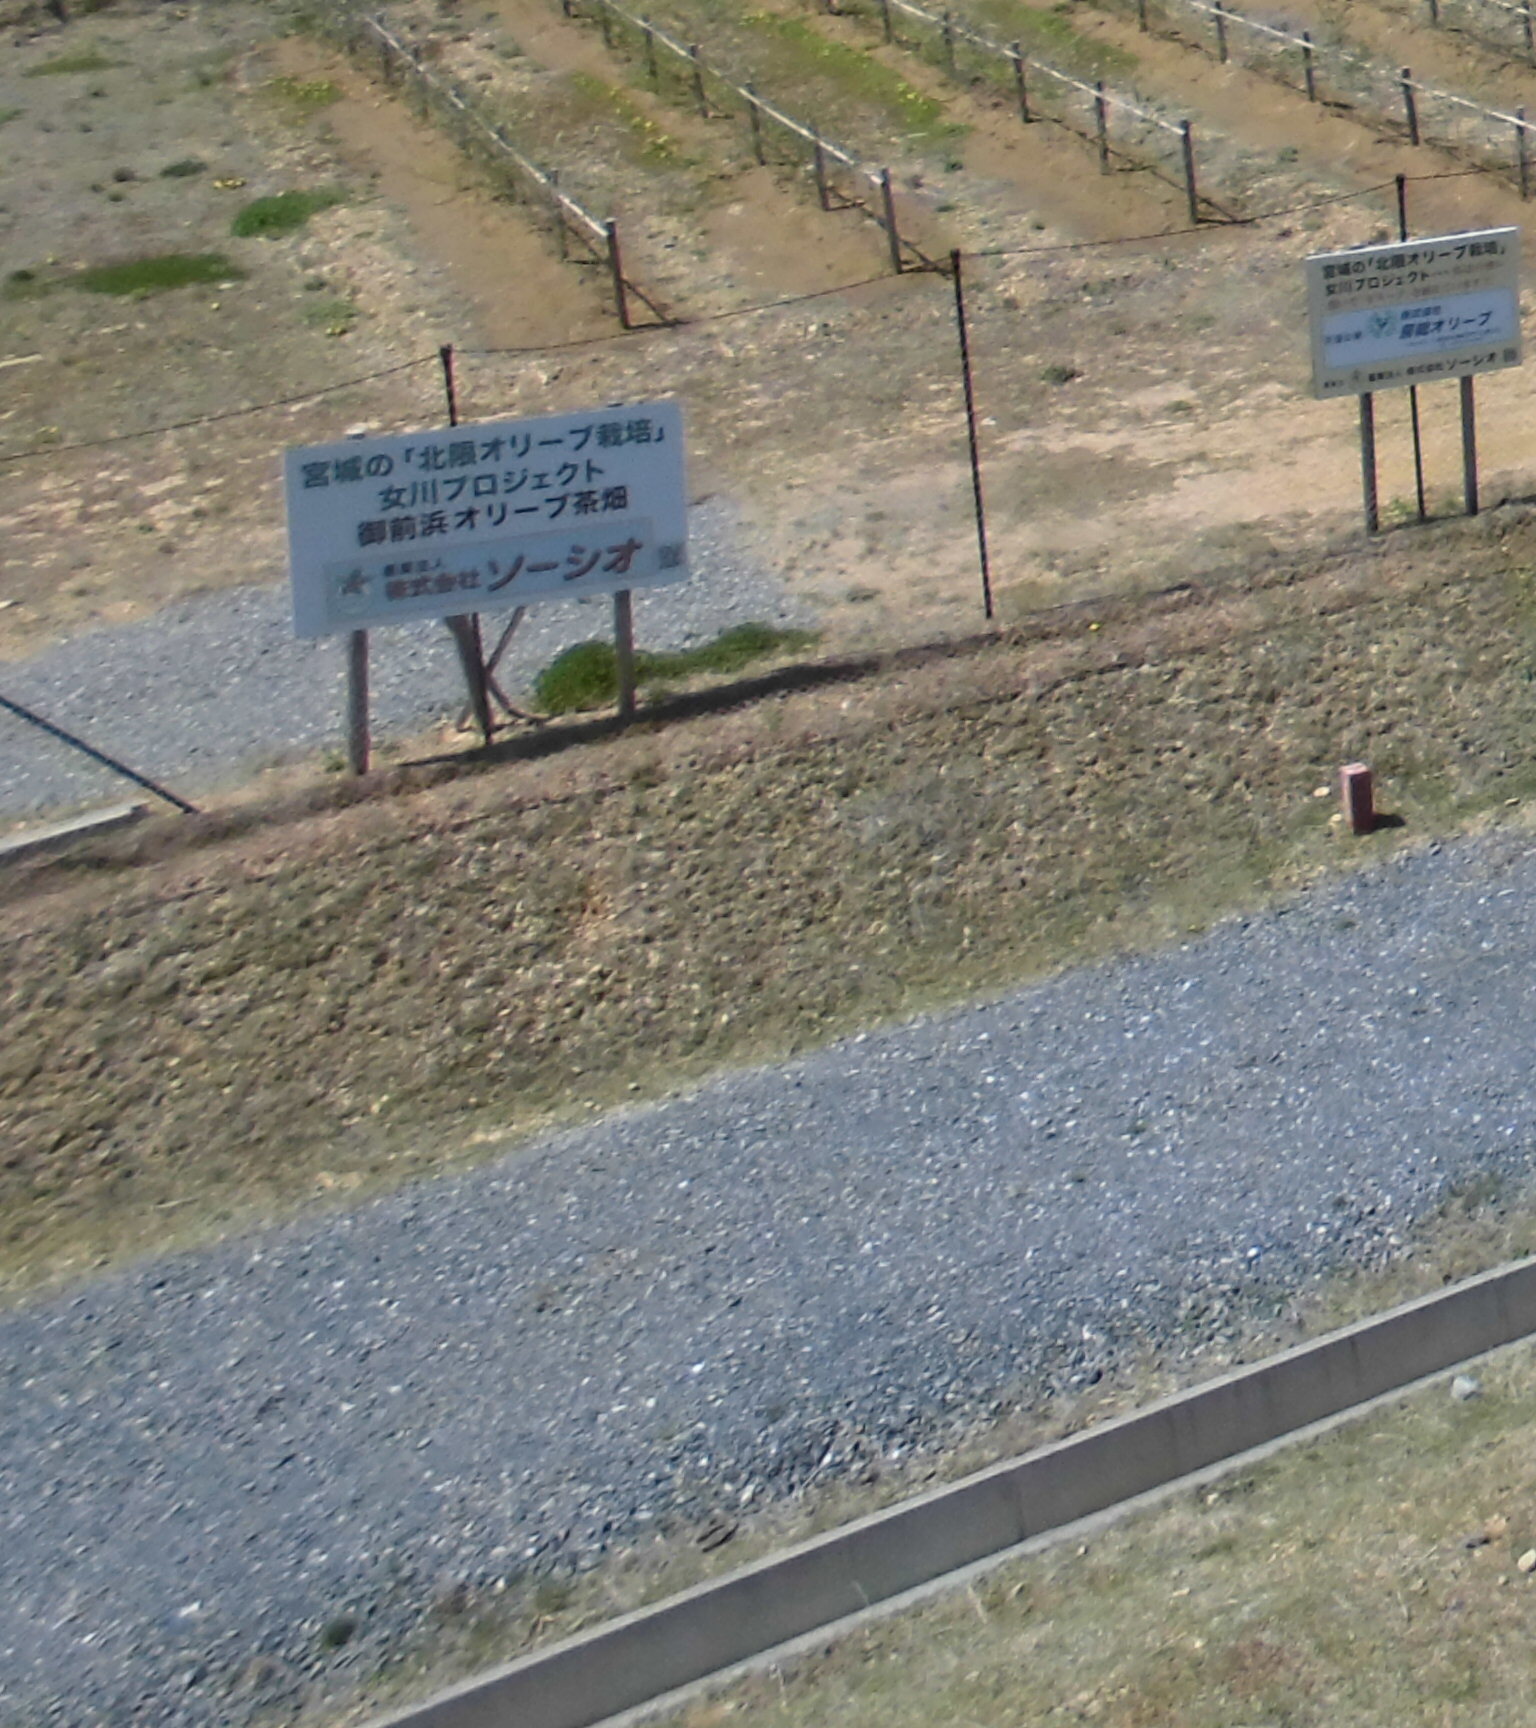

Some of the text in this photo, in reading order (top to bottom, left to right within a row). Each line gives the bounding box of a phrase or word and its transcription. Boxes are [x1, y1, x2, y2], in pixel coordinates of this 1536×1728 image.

[302, 418, 665, 490] 宮城の「北限オリーブ栽培」
[378, 458, 605, 512] 女川プロジェクト
[357, 485, 629, 548] 御前浜オリーブ茶畑
[487, 536, 645, 593] ソーシオ
